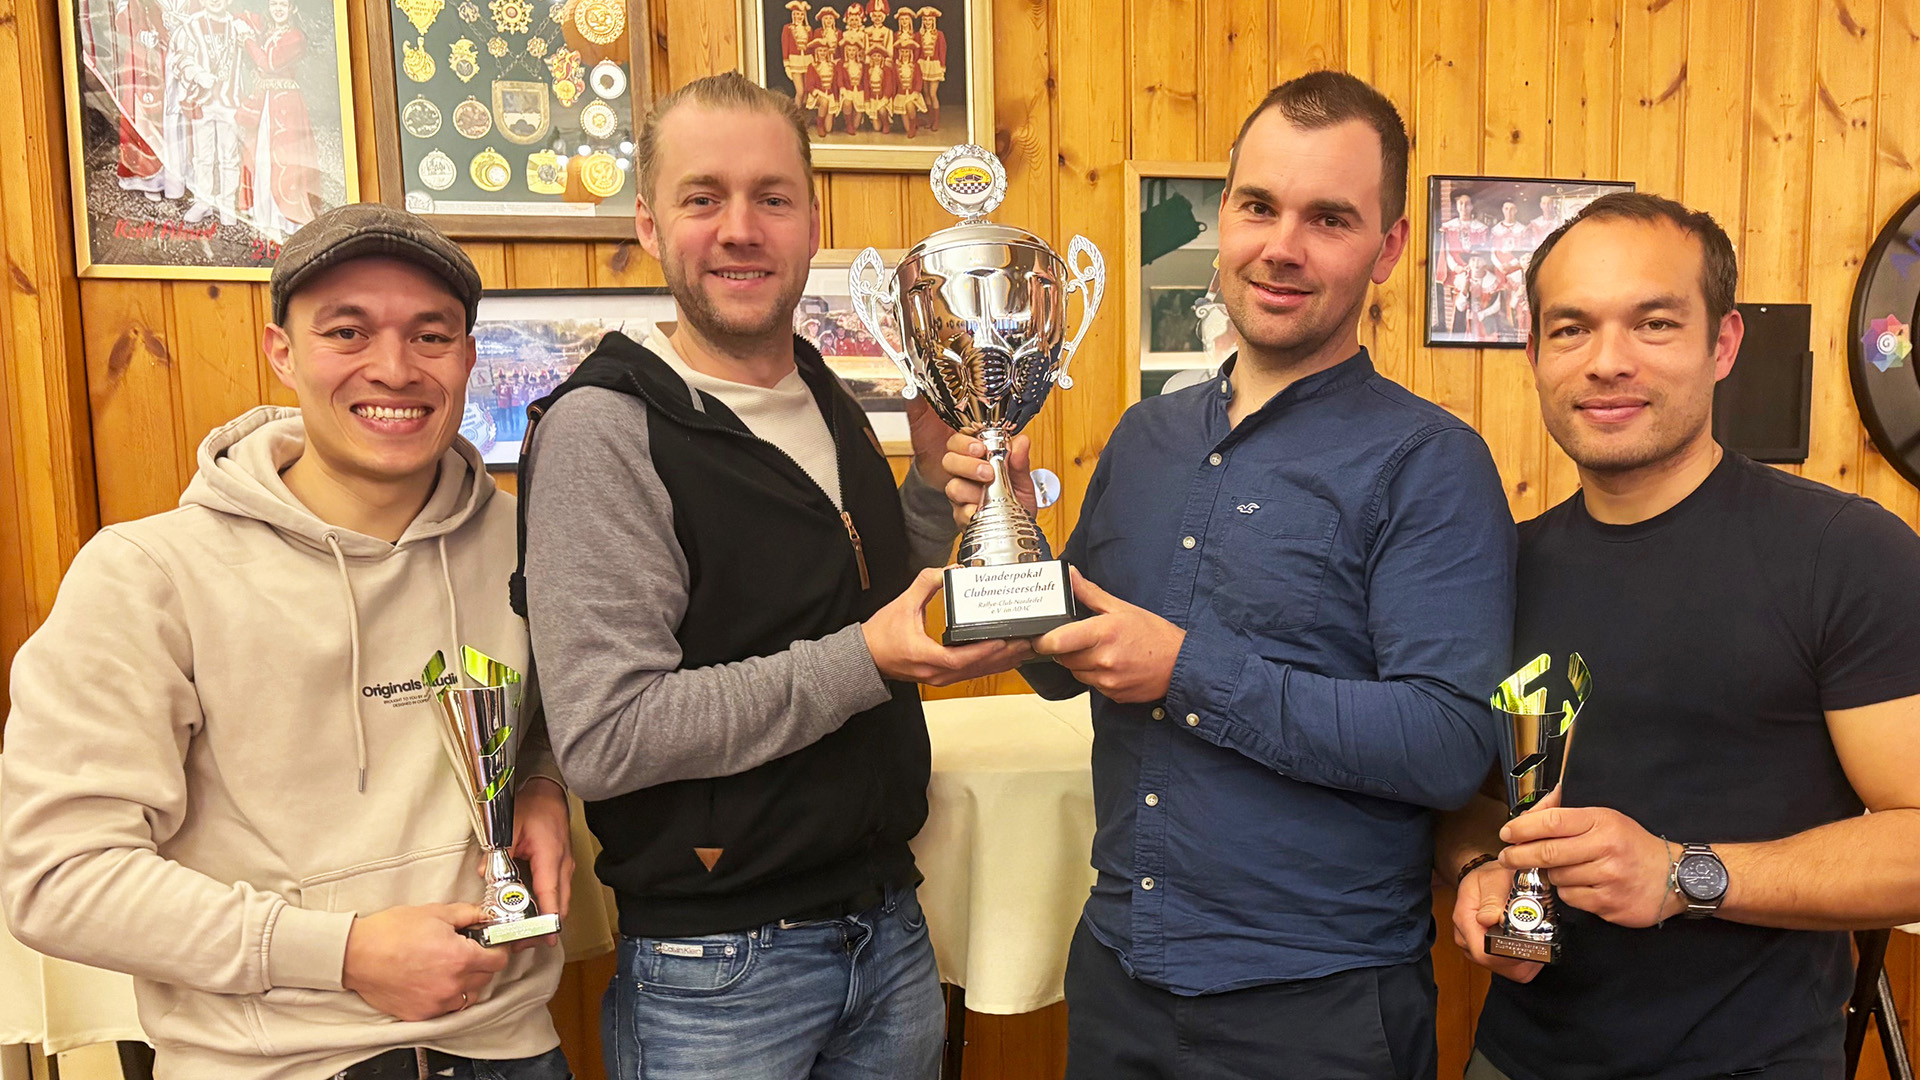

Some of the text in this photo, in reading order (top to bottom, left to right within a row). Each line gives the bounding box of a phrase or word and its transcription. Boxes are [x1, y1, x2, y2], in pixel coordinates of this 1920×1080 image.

[251, 239, 281, 260] 20
[975, 567, 1043, 583] Wanderpokal
[964, 581, 1055, 598] Clubmeisterschaft
[362, 673, 458, 698] Originals udi
[663, 944, 701, 955] Calvin Klein
